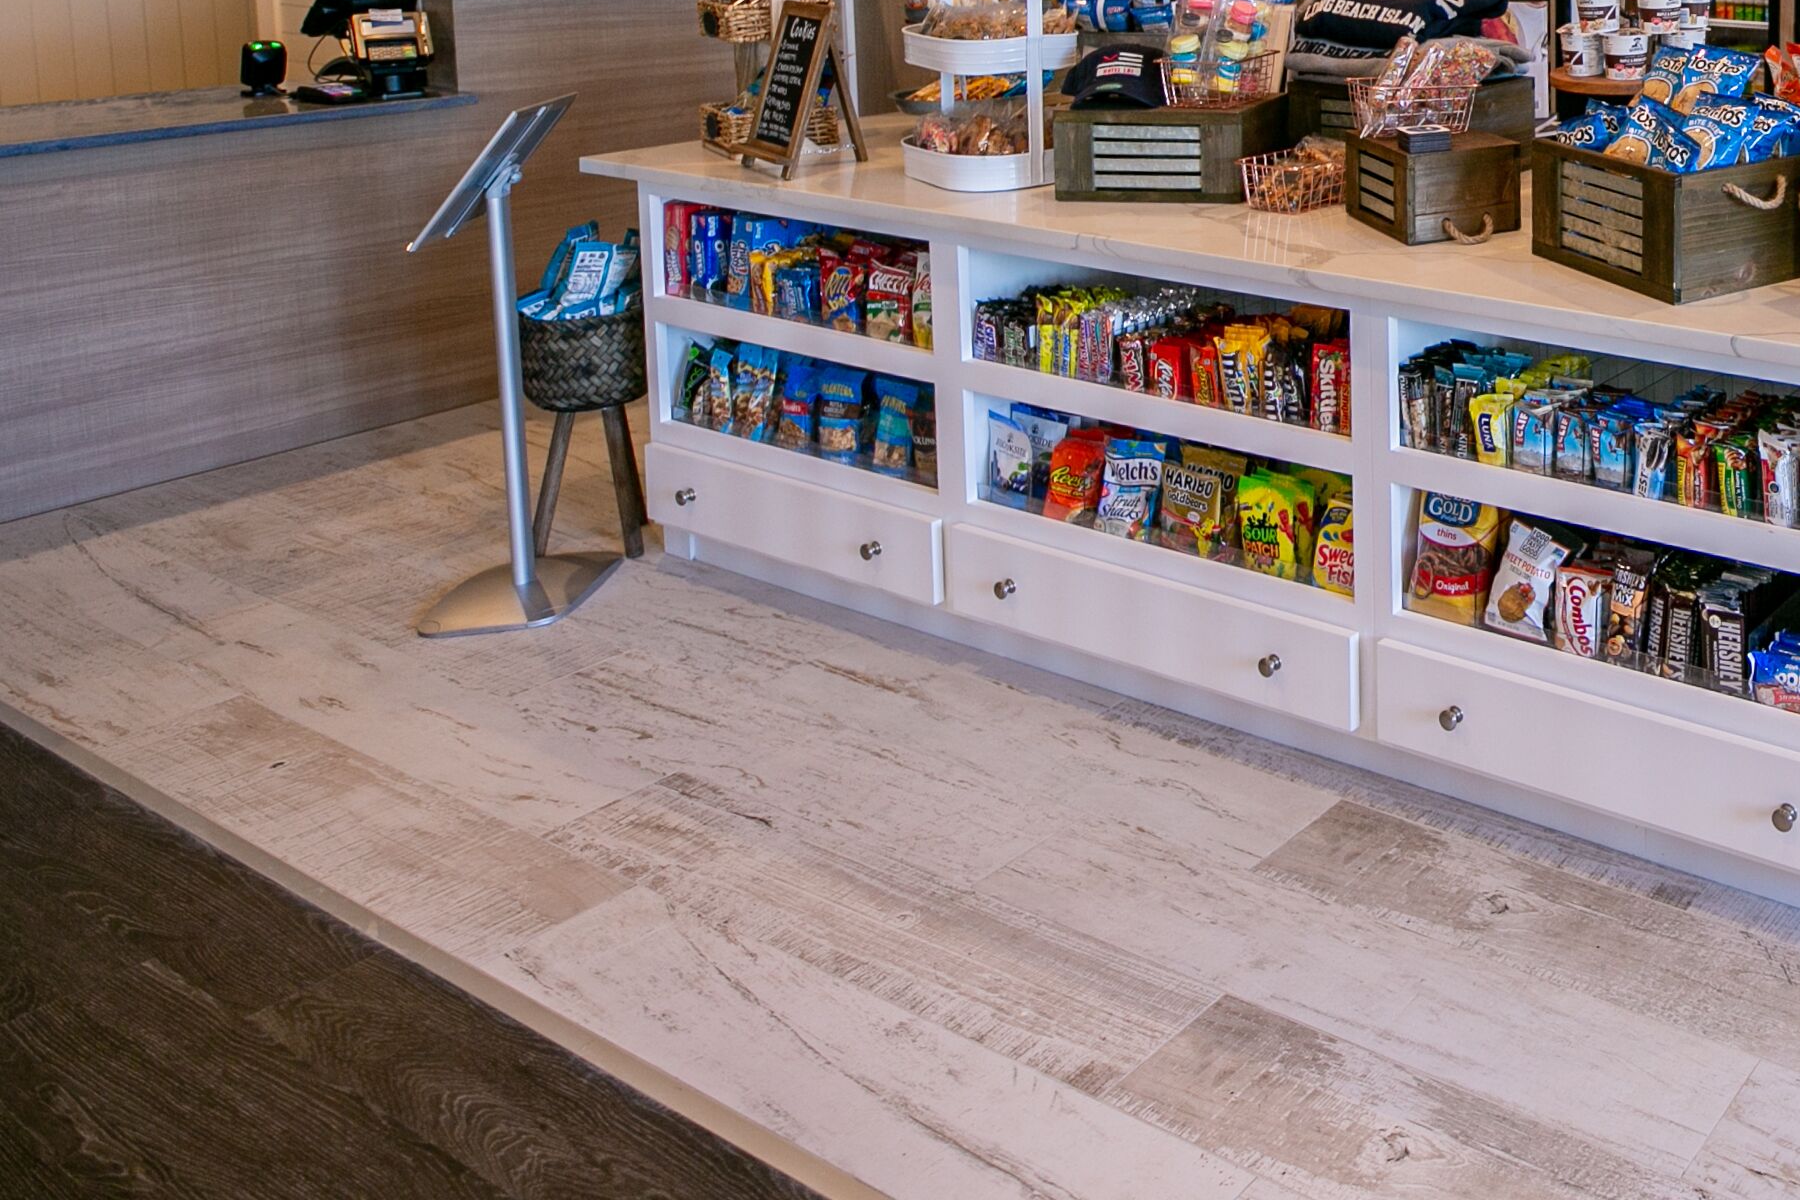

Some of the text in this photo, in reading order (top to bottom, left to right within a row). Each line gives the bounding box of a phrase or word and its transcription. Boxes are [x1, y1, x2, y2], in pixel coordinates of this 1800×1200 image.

[790, 17, 817, 40] Cookies
[1376, 5, 1427, 36] ISLAN
[1291, 39, 1325, 55] LONG
[1655, 56, 1686, 75] ostit
[1690, 55, 1747, 75] Tostitos
[694, 240, 703, 278] OREO
[714, 240, 728, 276] OREO
[1319, 358, 1337, 434] Skittles
[1480, 416, 1493, 450] LUNA
[1517, 412, 1530, 439] CLIF
[1559, 415, 1570, 442] CLIF
[1592, 427, 1602, 451] CLIF
[1050, 466, 1095, 492] Reese's
[1110, 461, 1158, 482] Welch's
[1165, 468, 1214, 498] HARIBO
[1637, 471, 1648, 497] EST
[1100, 504, 1142, 520] Snacks
[1112, 495, 1142, 508] Fruit
[1428, 496, 1473, 522] GOLD
[1243, 525, 1278, 542] SOUR
[1436, 528, 1457, 541] thins
[1532, 529, 1551, 542] FOOD
[1243, 541, 1280, 559] PATCH
[1504, 551, 1522, 566] WEET
[1435, 580, 1470, 594] Original
[1568, 577, 1593, 657] Combos
[1668, 607, 1684, 681] HERSHEY'S
[1718, 620, 1743, 693] HERSHEY
